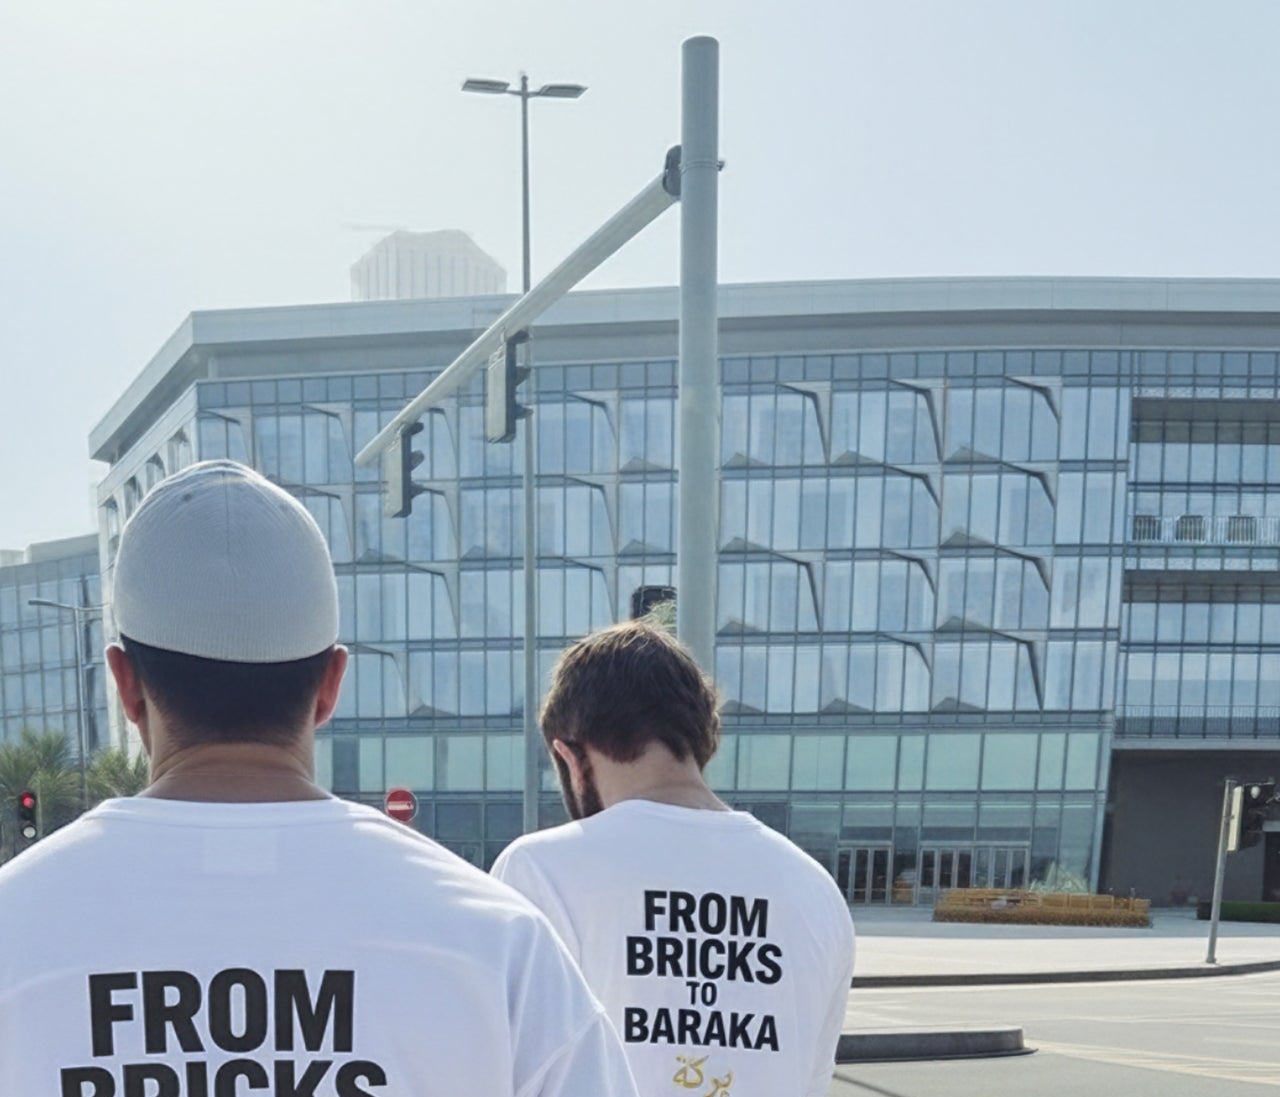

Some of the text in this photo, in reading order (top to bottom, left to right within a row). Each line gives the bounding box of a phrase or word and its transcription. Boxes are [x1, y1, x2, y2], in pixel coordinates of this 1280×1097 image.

[643, 889, 769, 938] FROM
[626, 935, 783, 985] BRICKS
[88, 967, 355, 1058] FROM
[686, 981, 718, 1007] TO
[624, 1007, 780, 1052] BARAKA
